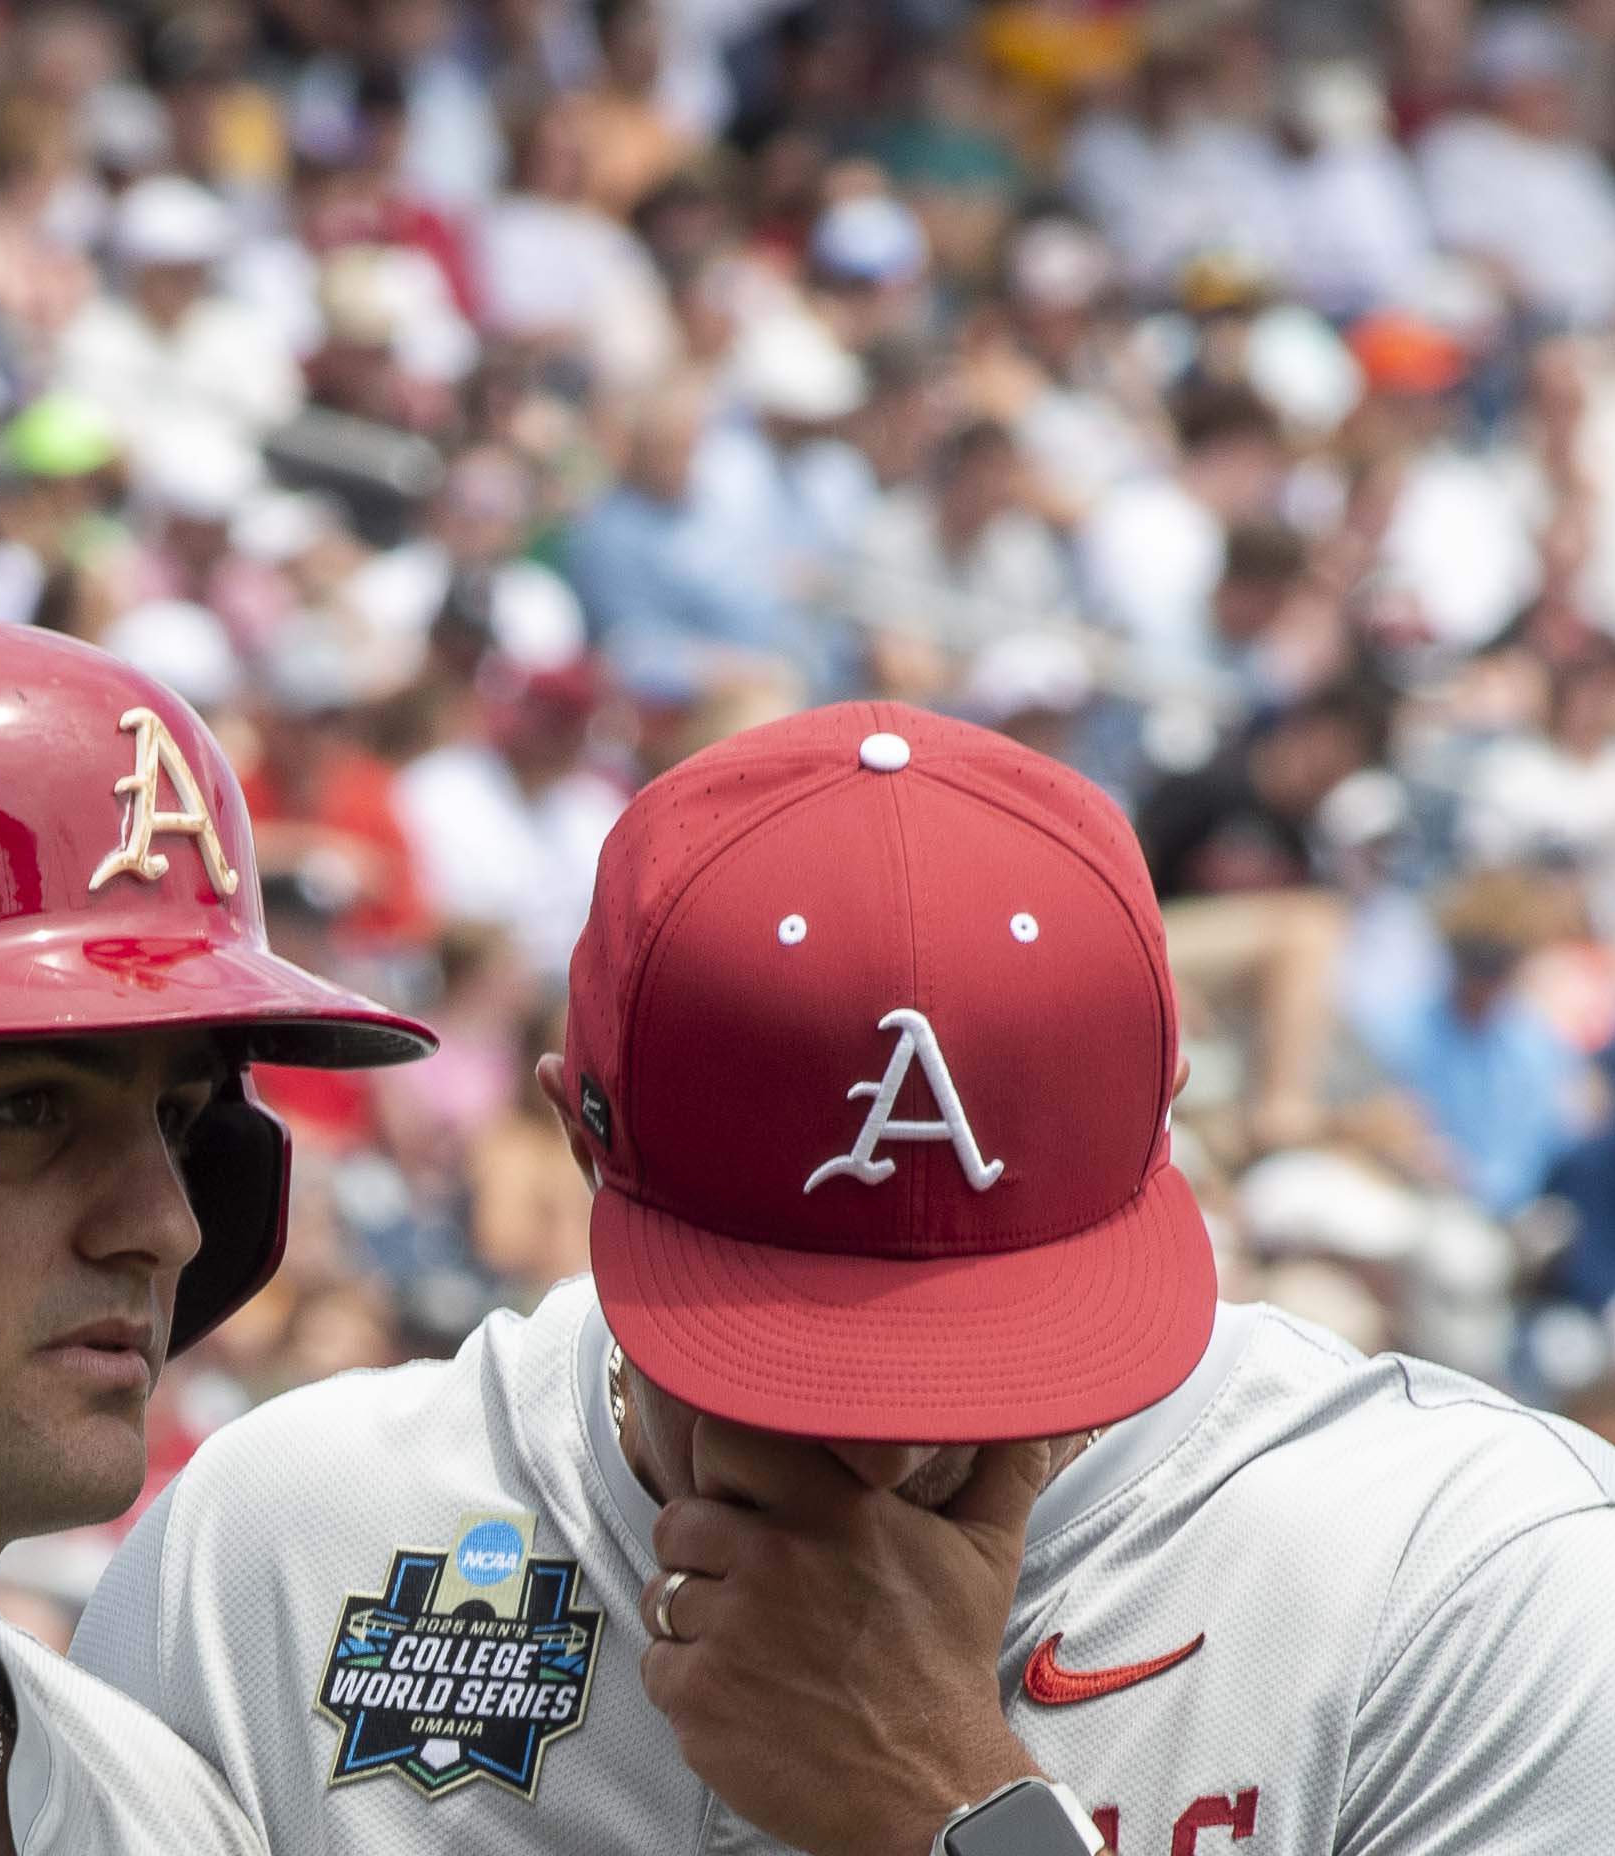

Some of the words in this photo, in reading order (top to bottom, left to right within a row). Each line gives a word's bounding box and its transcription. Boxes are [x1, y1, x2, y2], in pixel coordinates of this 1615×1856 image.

[88, 706, 238, 895] A
[803, 1008, 1004, 1194] A
[461, 1550, 519, 1571] NCAA
[469, 1619, 528, 1640] MEN'S
[389, 1635, 539, 1681] COLLEGE
[330, 1668, 454, 1714] WORLD
[454, 1678, 577, 1721] SERIES
[411, 1716, 484, 1738] OMAHA
